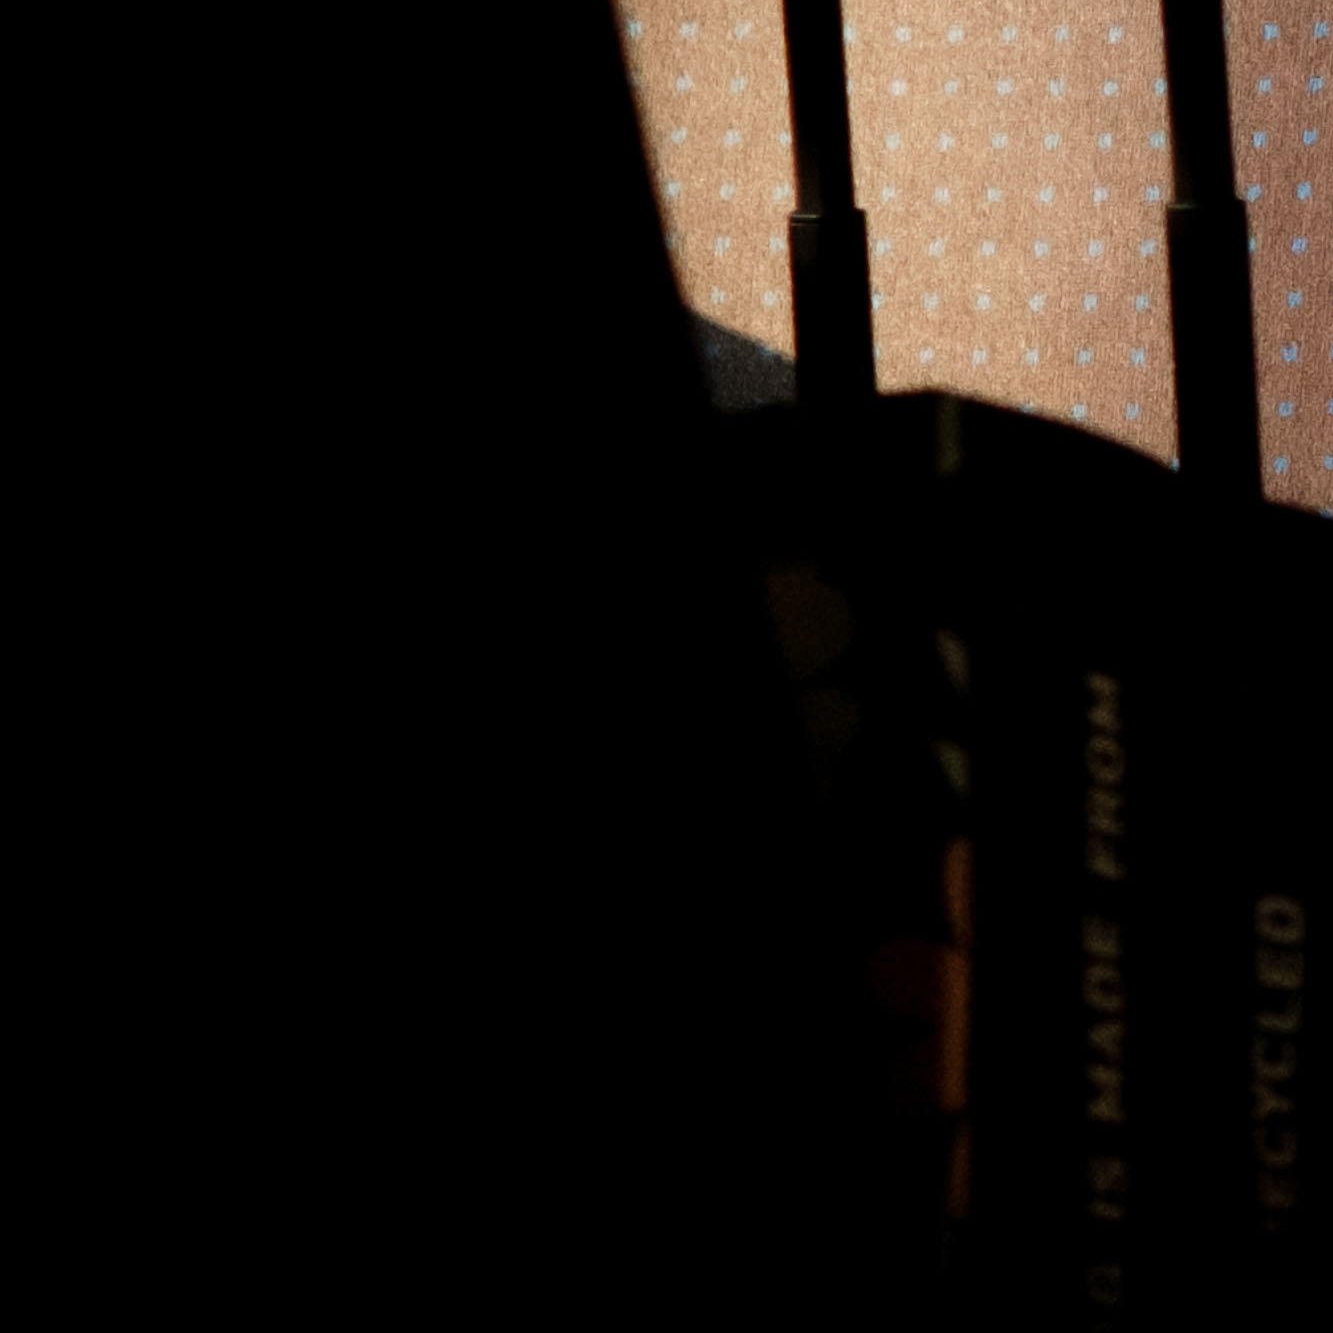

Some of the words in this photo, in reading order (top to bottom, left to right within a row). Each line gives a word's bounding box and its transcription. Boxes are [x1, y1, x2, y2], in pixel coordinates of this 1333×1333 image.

[1083, 668, 1126, 881] FROM
[1082, 915, 1126, 1126] MADE
[1250, 892, 1306, 1232] ECYCLED
[1086, 1156, 1128, 1222] IS
